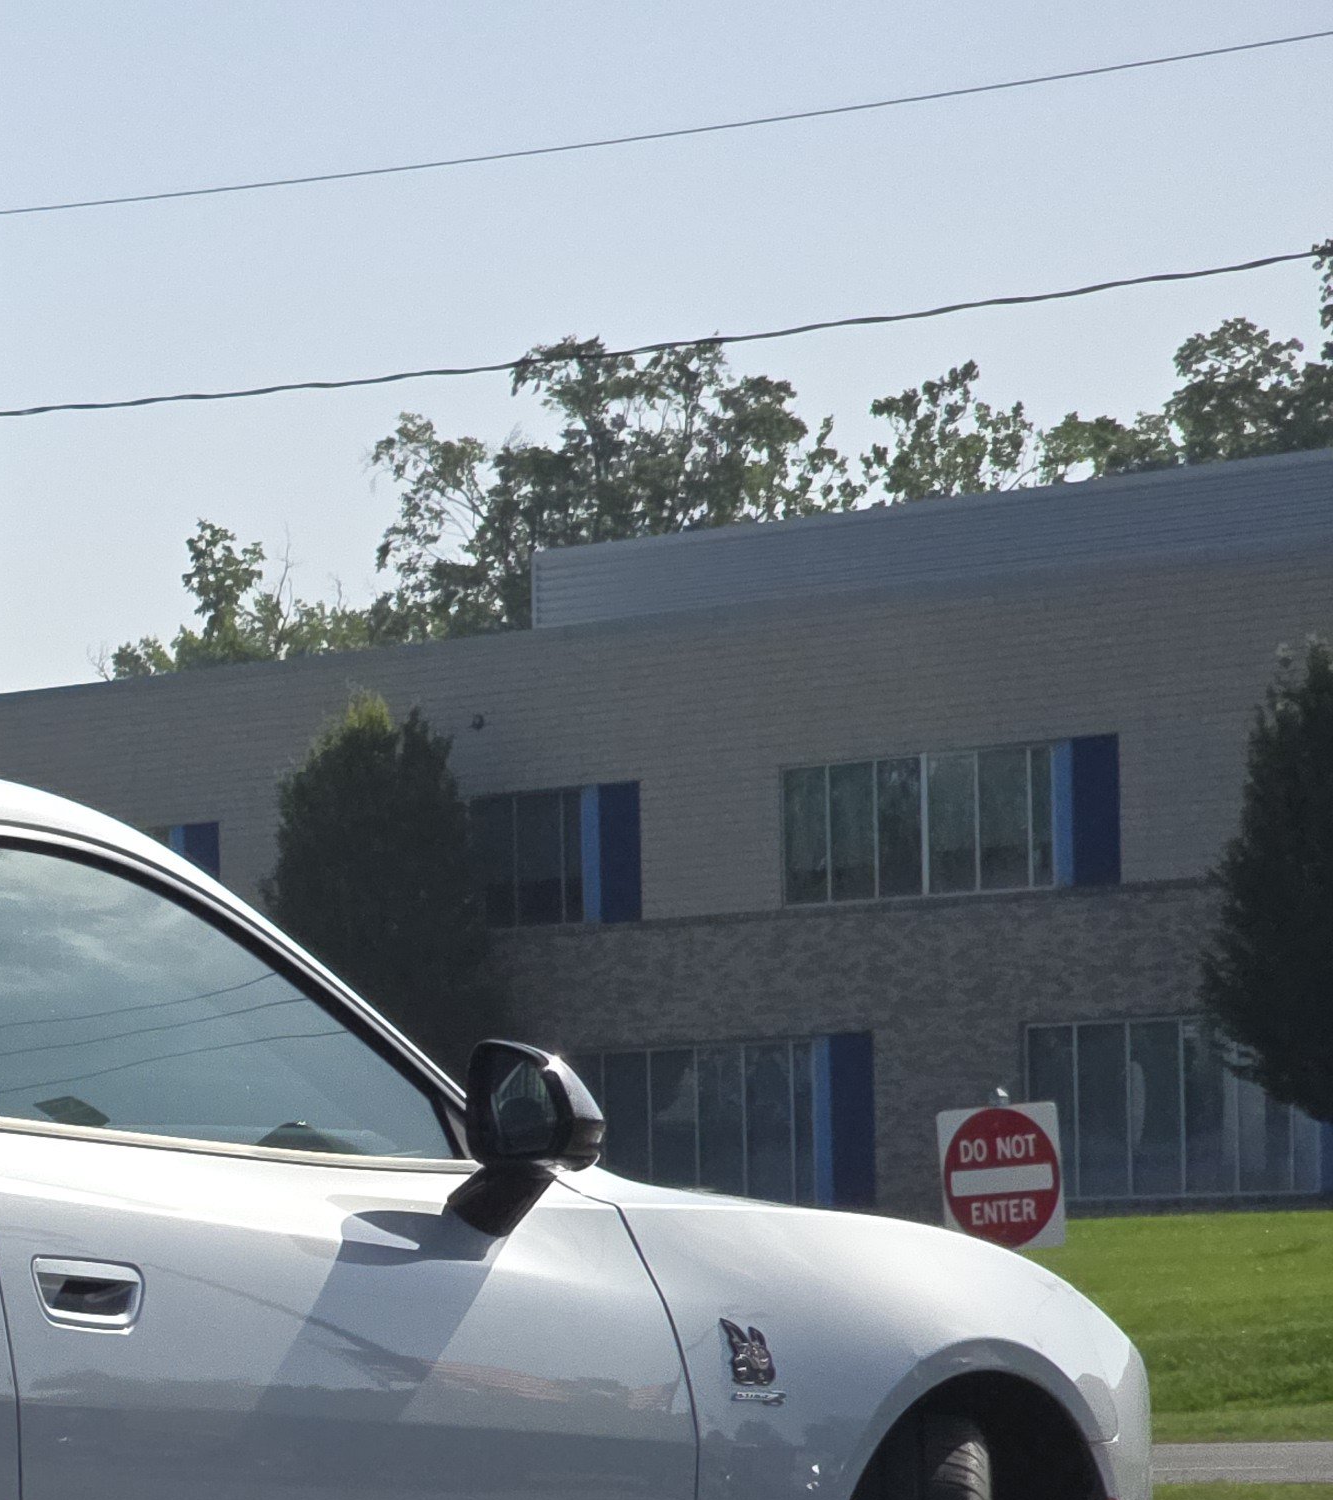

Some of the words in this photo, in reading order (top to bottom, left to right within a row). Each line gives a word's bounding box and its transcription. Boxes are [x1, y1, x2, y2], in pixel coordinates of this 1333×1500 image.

[959, 1138, 988, 1164] DO
[996, 1133, 1037, 1161] NOT
[970, 1198, 1037, 1226] ENTER
